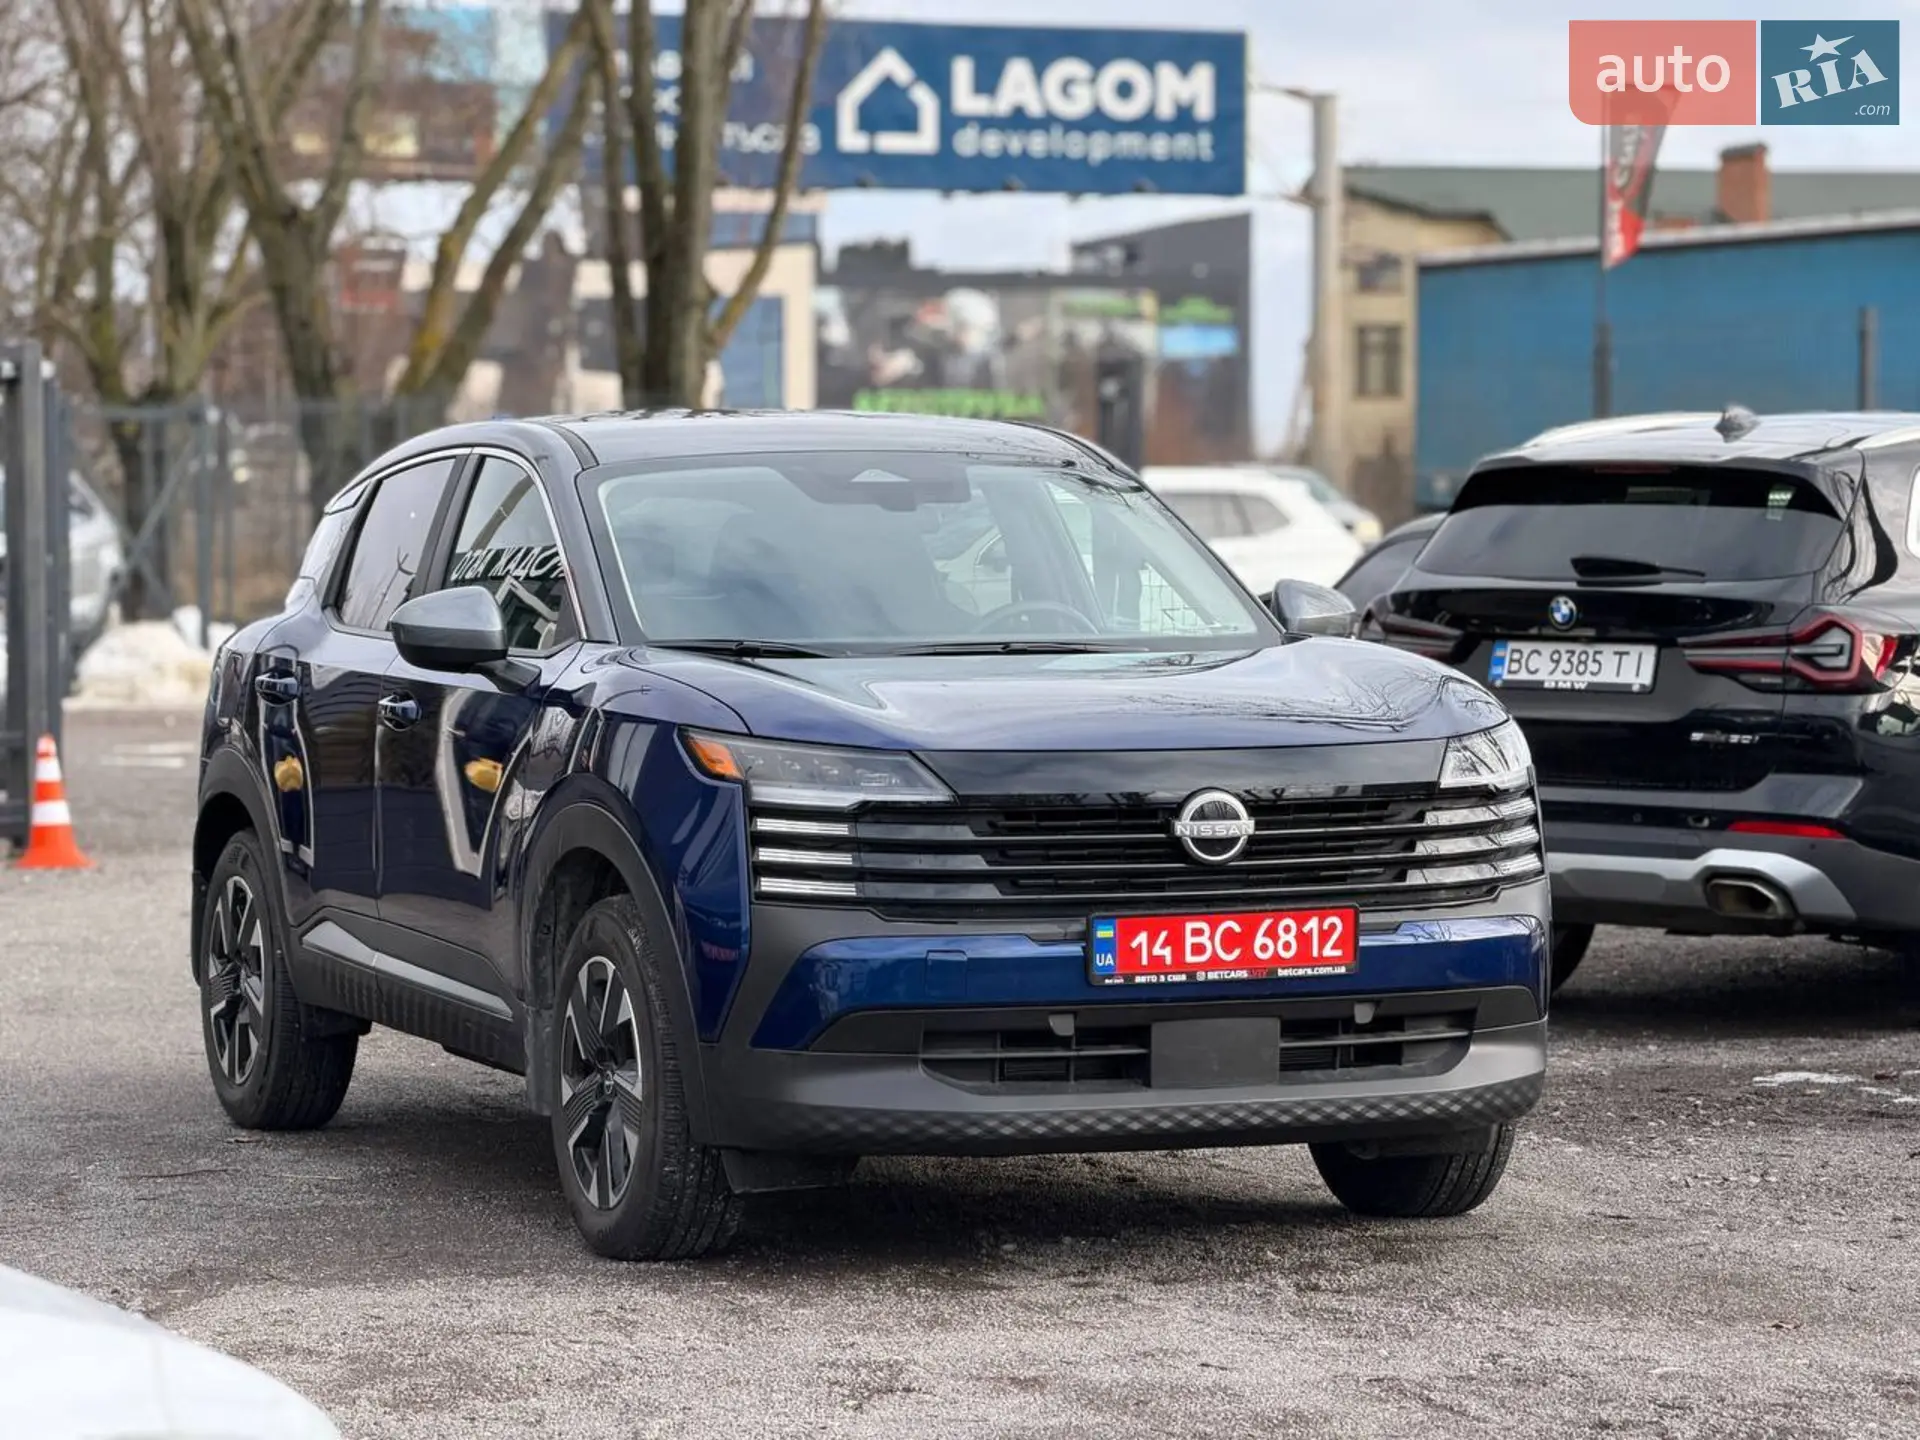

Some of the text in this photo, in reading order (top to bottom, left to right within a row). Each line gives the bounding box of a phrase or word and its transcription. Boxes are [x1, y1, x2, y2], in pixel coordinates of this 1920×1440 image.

[951, 55, 1216, 122] LAGOM
[952, 121, 1215, 167] development
[1507, 649, 1542, 675] BC
[1549, 649, 1604, 677] 9385
[1176, 823, 1254, 837] NISSAN
[1130, 916, 1344, 966] 14 BC 6812
[1096, 953, 1114, 967] UA
[1277, 965, 1347, 977] betcars.com.ua
